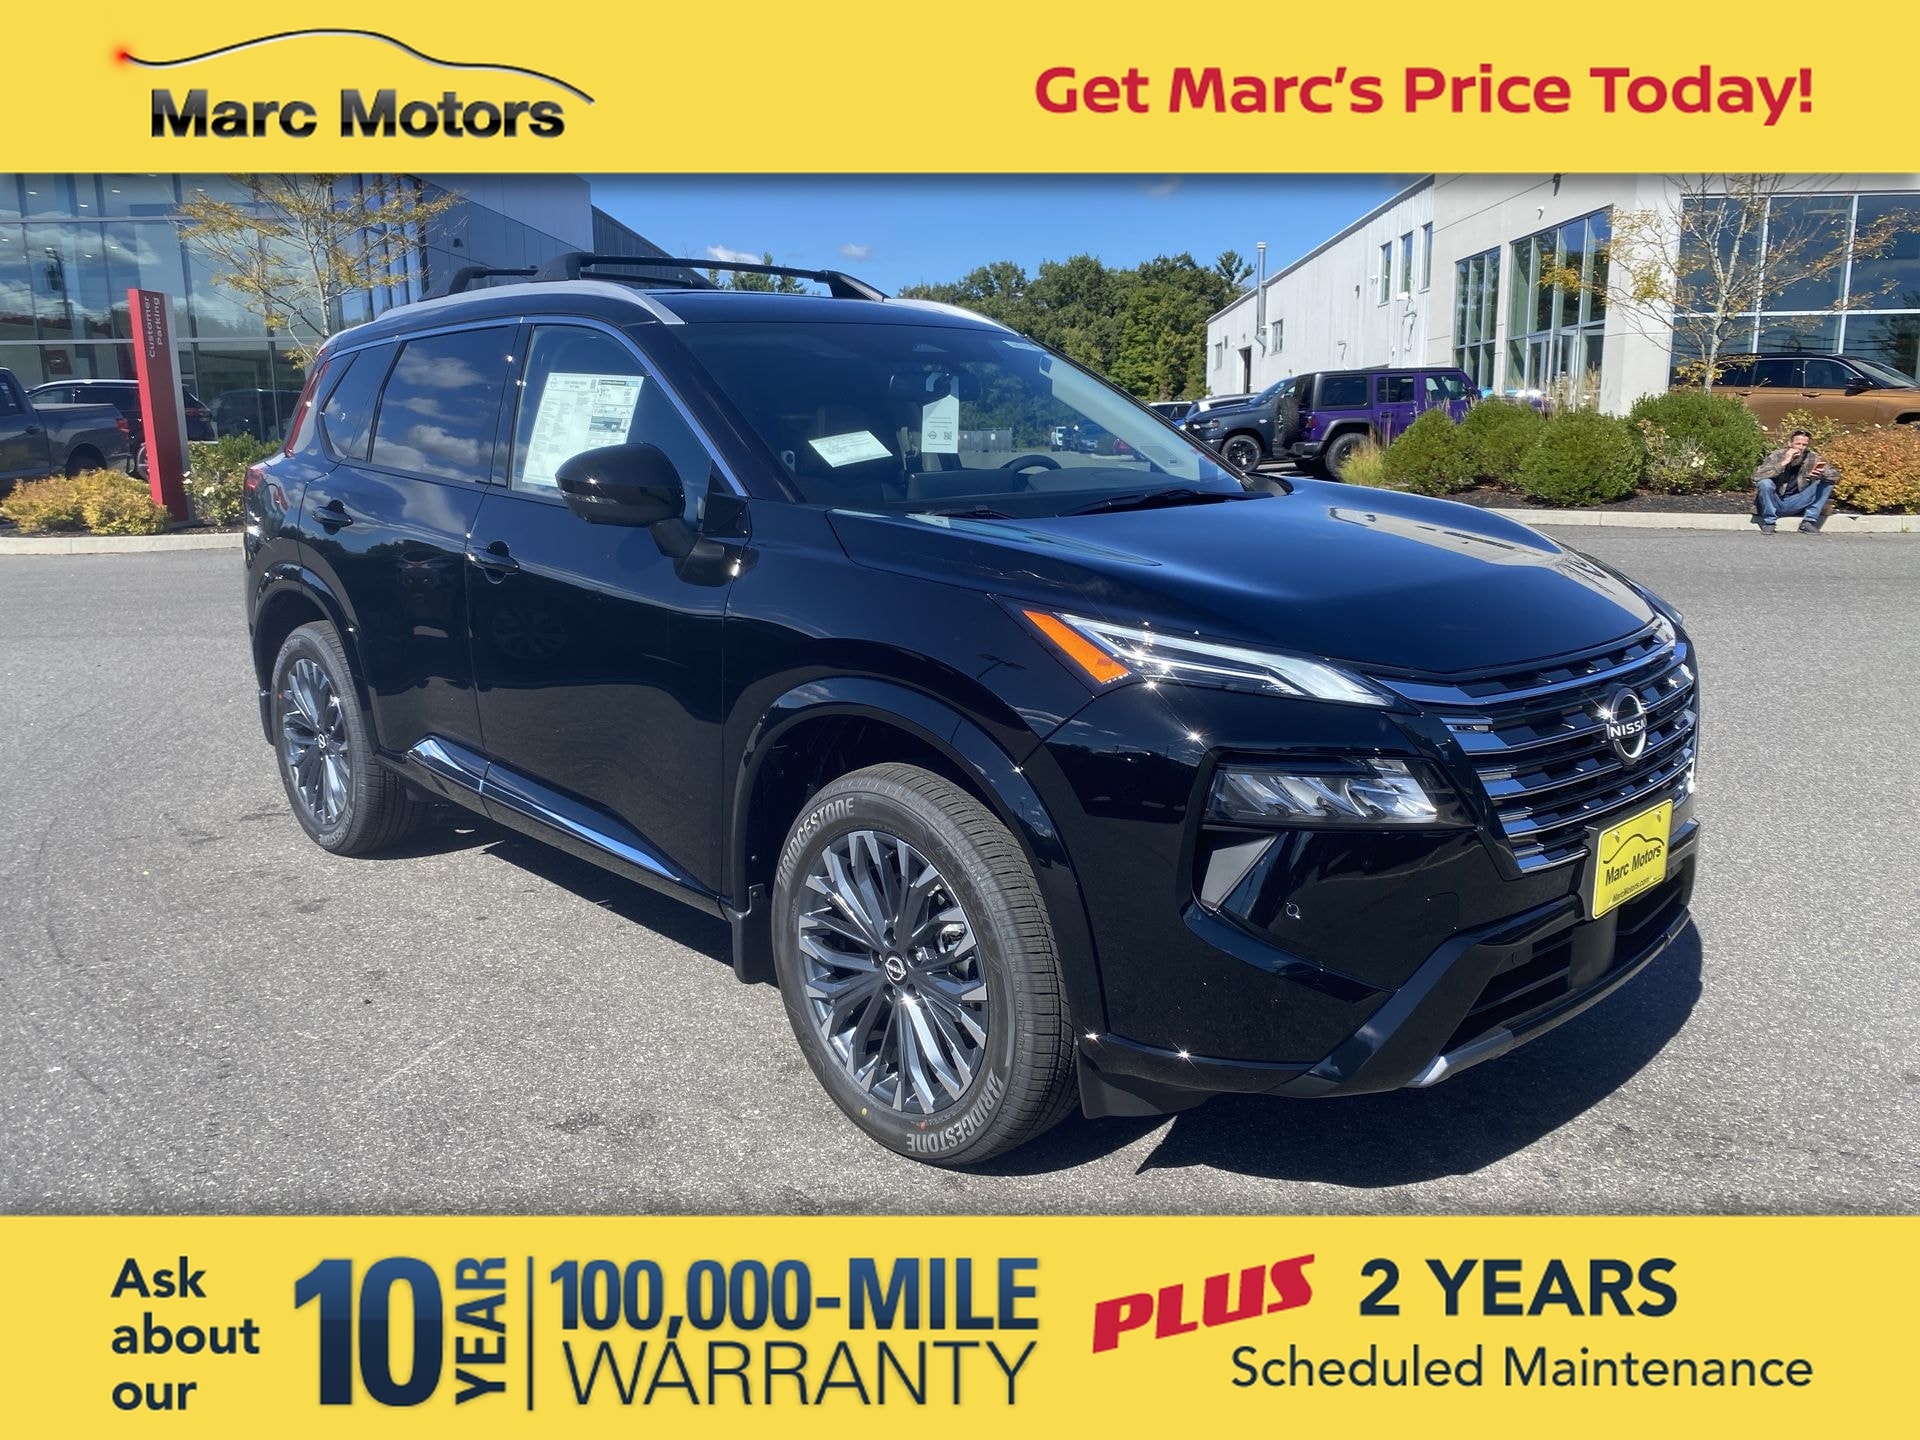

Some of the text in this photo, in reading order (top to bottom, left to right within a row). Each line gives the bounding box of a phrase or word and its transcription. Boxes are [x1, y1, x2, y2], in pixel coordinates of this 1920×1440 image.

[144, 296, 155, 358] Customer
[1605, 845, 1661, 886] Marc Motors
